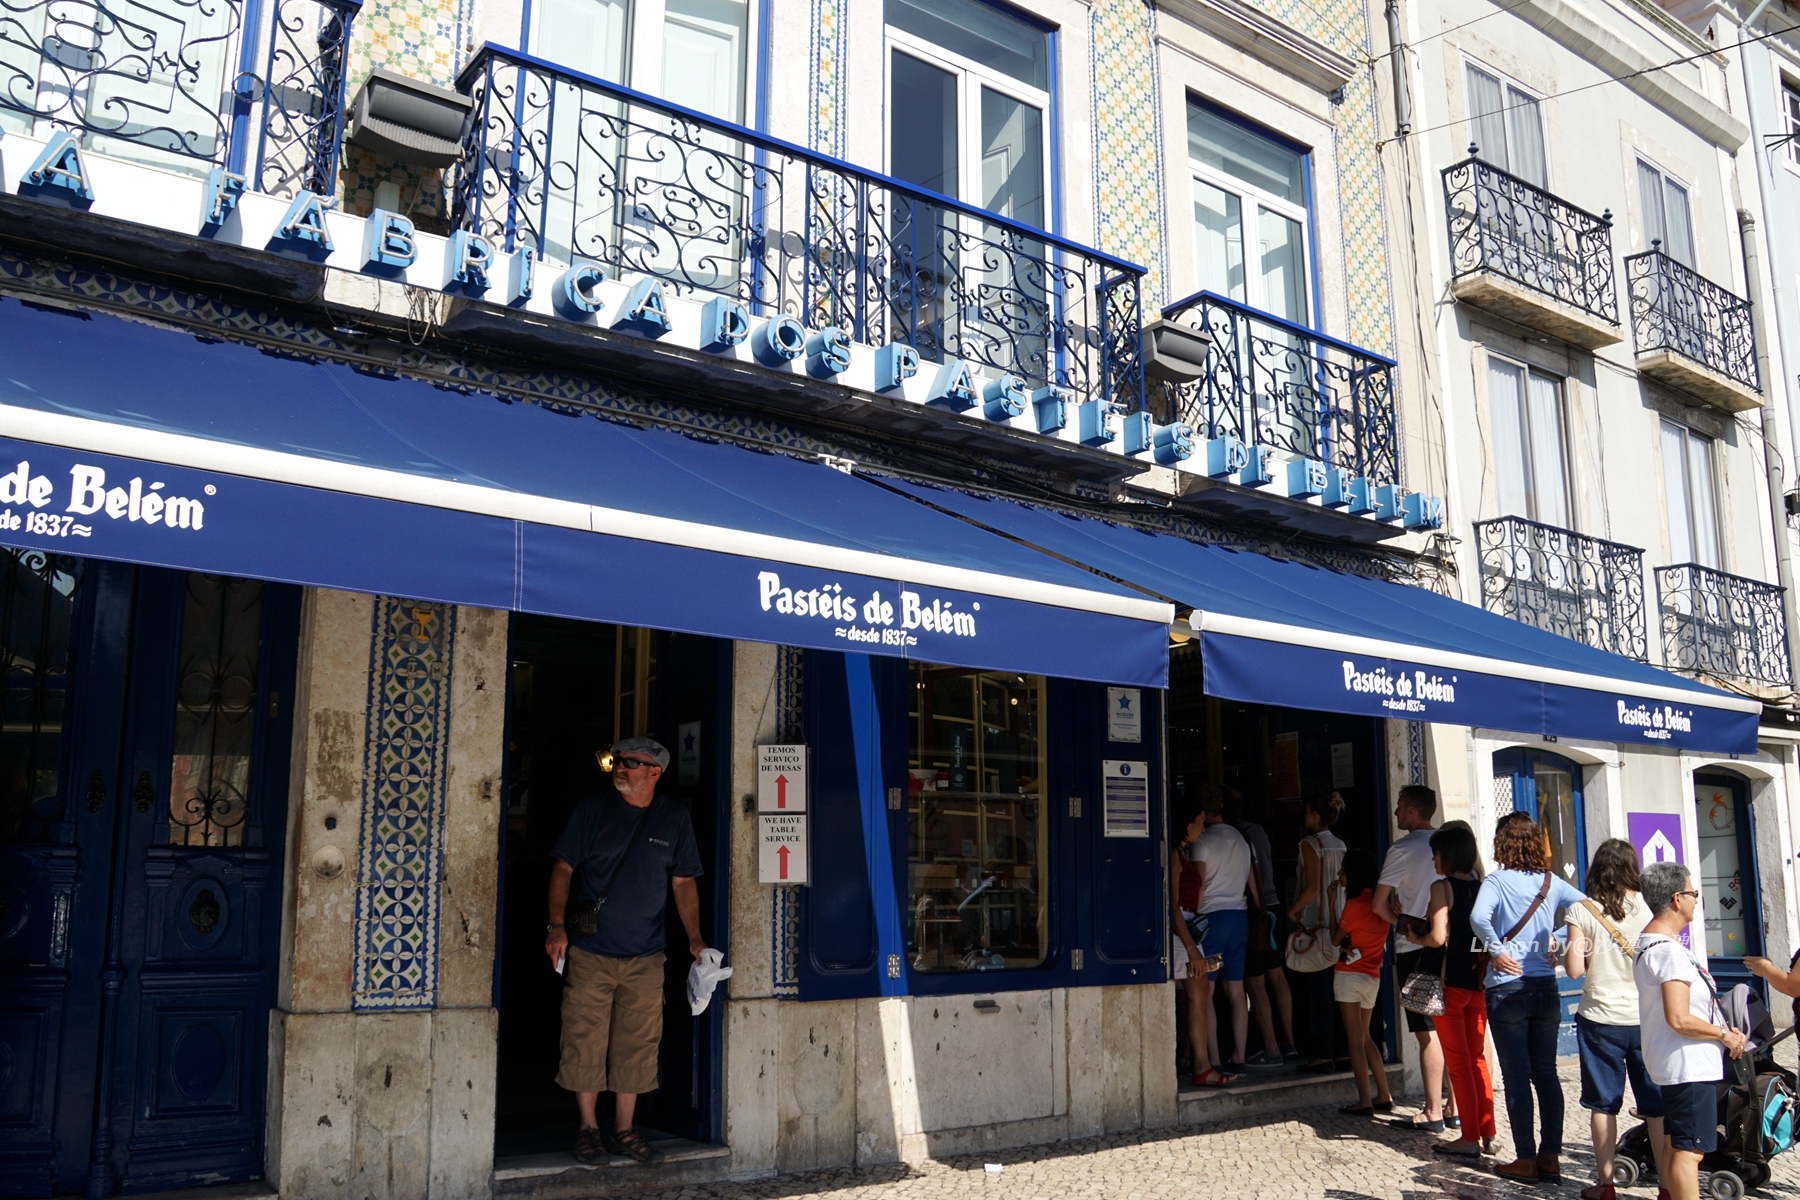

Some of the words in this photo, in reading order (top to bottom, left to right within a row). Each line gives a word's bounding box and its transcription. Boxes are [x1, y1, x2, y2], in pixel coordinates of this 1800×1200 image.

[0, 124, 95, 212] A
[699, 296, 852, 379] DOS
[1206, 436, 1277, 488] DE
[0, 460, 53, 508] de
[757, 570, 857, 622] Pastéis
[863, 590, 894, 626] de
[1342, 660, 1394, 696] Pastéis
[1396, 671, 1413, 698] de
[1652, 707, 1664, 729] de
[767, 746, 796, 754] TEMOS
[763, 755, 800, 764] SERVIÇO
[761, 764, 773, 772] DE
[774, 764, 802, 772] MESAS
[764, 816, 778, 824] WE
[779, 816, 802, 824] HAVE
[770, 826, 797, 834] TABLE
